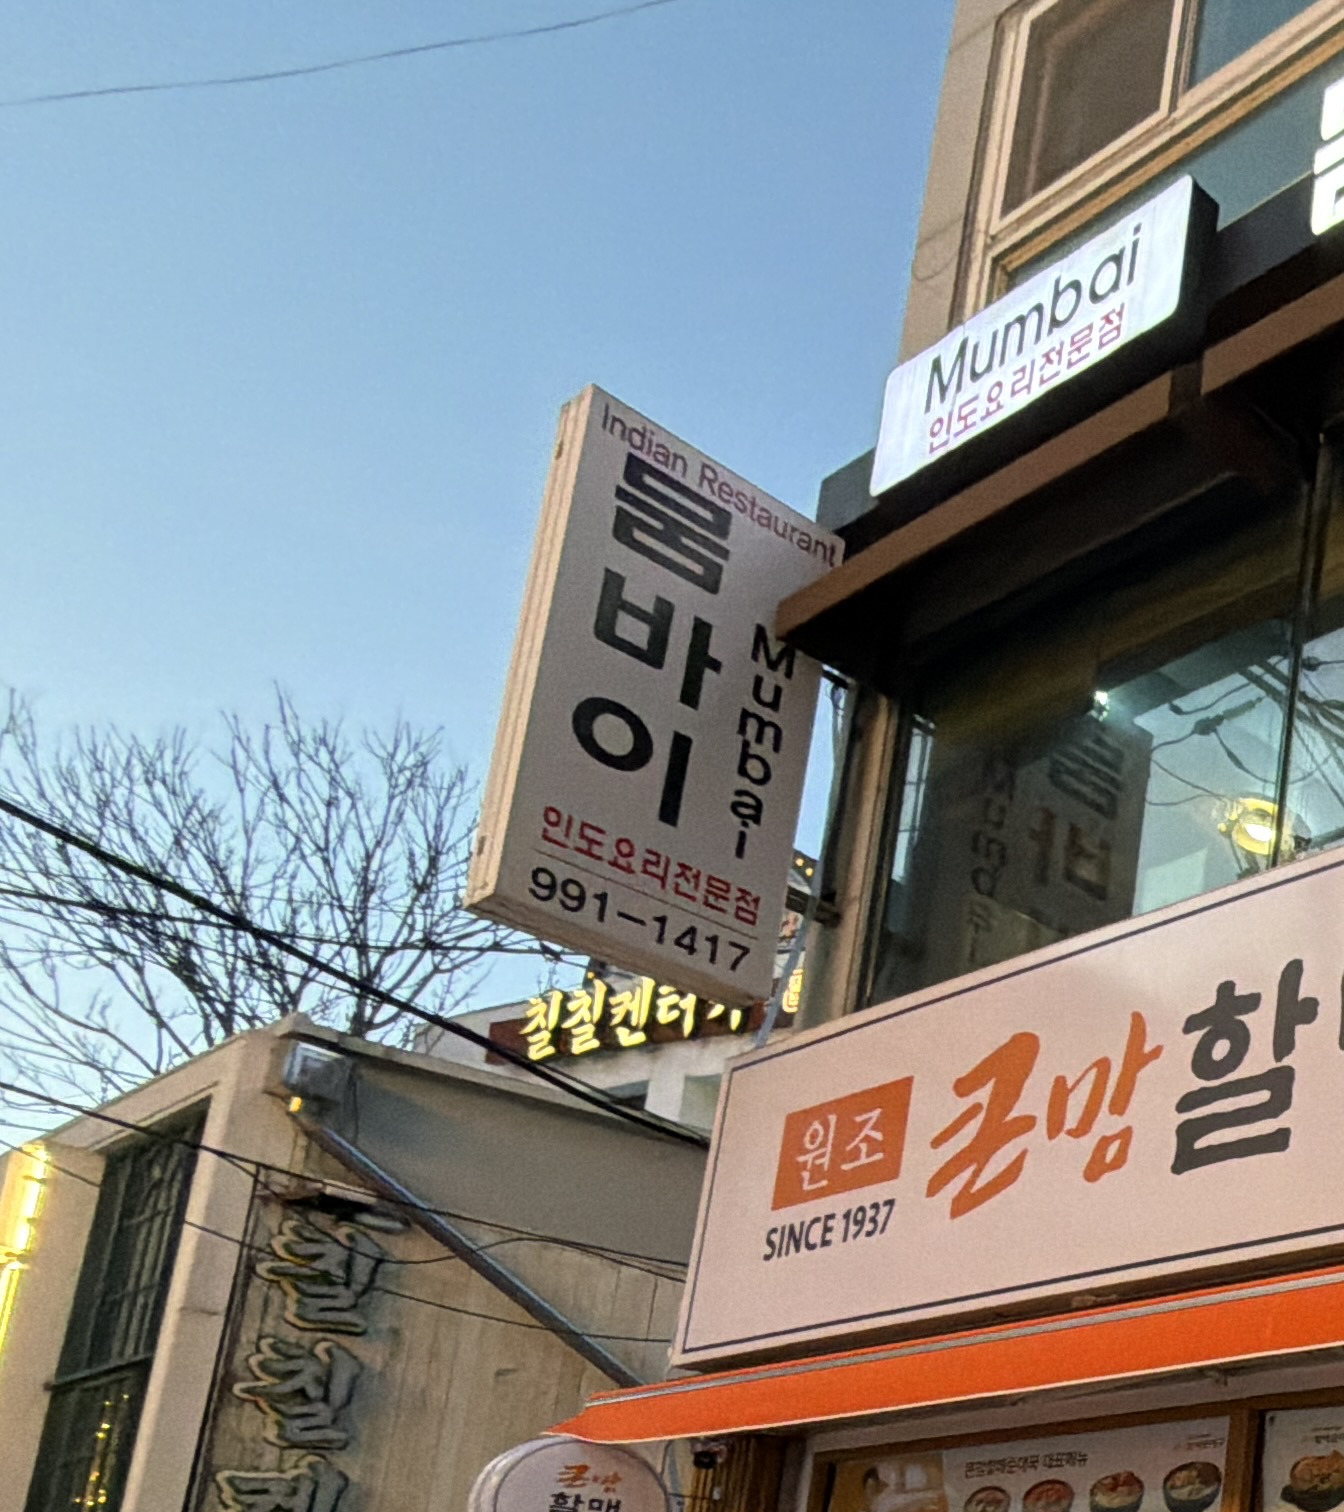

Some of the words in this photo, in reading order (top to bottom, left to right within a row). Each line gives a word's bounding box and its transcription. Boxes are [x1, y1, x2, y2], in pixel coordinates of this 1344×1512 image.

[924, 225, 1143, 413] Mumbai
[927, 304, 1126, 454] 인도요리전문점
[601, 403, 688, 480] Indian
[699, 464, 838, 568] Restaurant
[572, 451, 731, 827] 뭄바이
[730, 624, 796, 859] Mumbai
[528, 866, 751, 972] 991-1417
[542, 805, 760, 926] 인도요리전문점
[519, 972, 743, 1061] 칠칠켄터
[795, 1106, 886, 1191] 원조
[763, 1213, 834, 1262] SINCE
[841, 1201, 896, 1244] 1937
